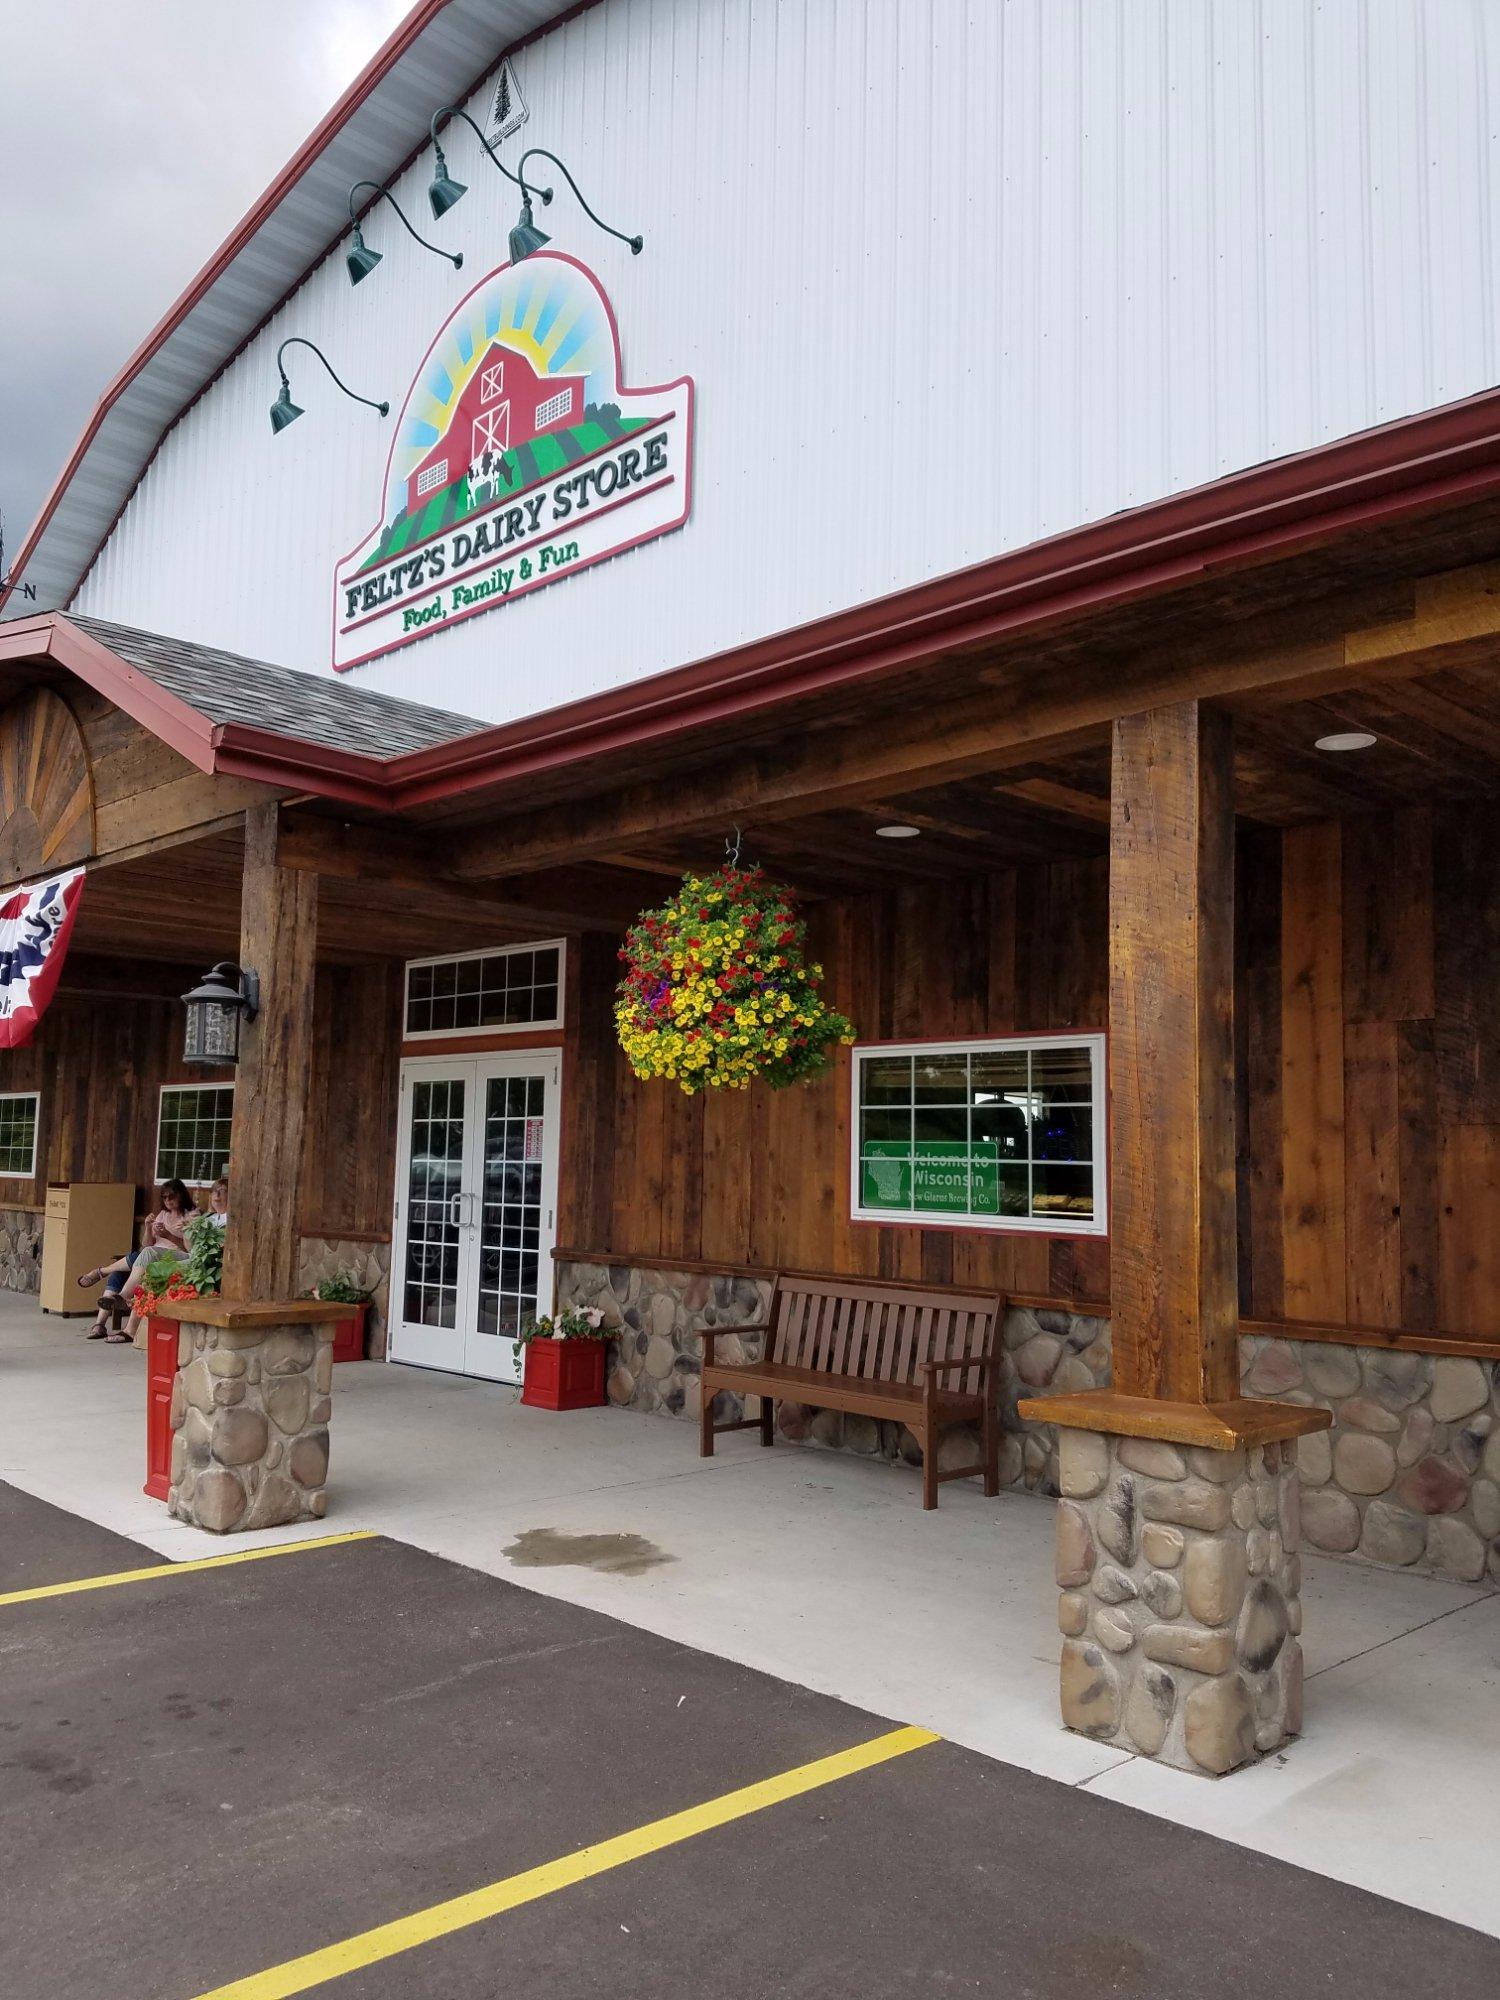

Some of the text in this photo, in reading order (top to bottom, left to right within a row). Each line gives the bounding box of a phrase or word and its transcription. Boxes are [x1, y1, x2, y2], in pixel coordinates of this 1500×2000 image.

[345, 431, 667, 618] FELTZ'S DAIRY STORE
[402, 541, 579, 632] Food, Family & Fun
[911, 1170, 984, 1187] Wisconsin
[974, 1153, 989, 1168] to
